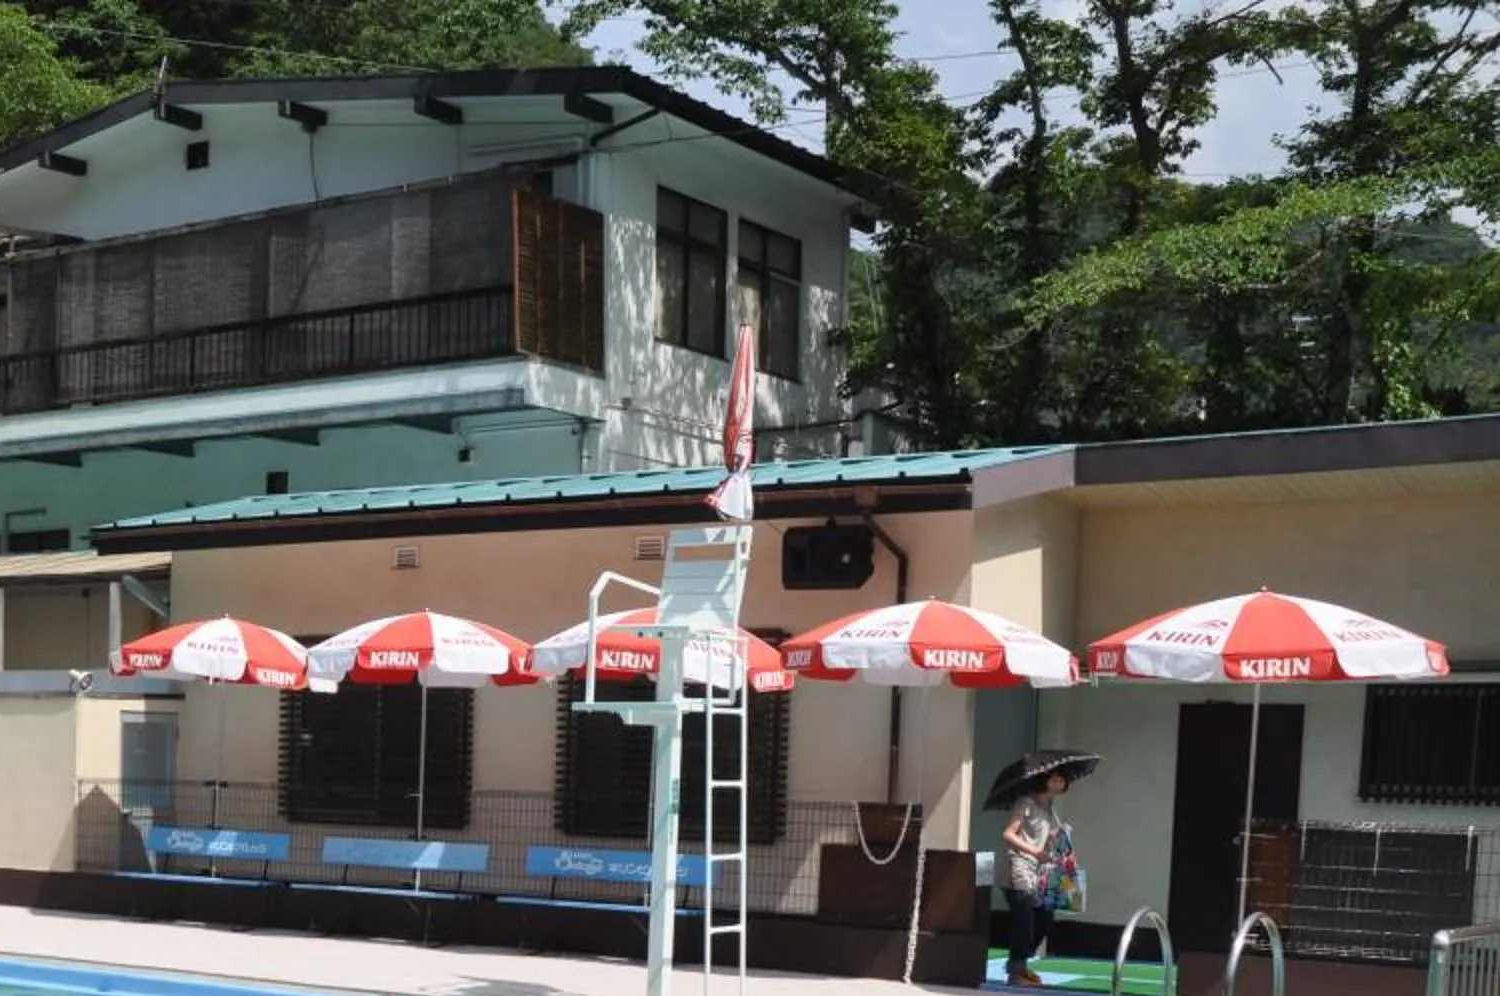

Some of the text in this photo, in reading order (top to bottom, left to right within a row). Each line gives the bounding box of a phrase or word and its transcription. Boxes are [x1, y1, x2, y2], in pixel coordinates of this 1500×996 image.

[1147, 629, 1221, 647] KIRIN
[371, 651, 420, 667] KIRIN
[601, 650, 656, 670] KIRIN
[924, 650, 985, 669] KIRIN
[1240, 657, 1311, 678] KIRIN
[256, 667, 296, 686] KIRIN
